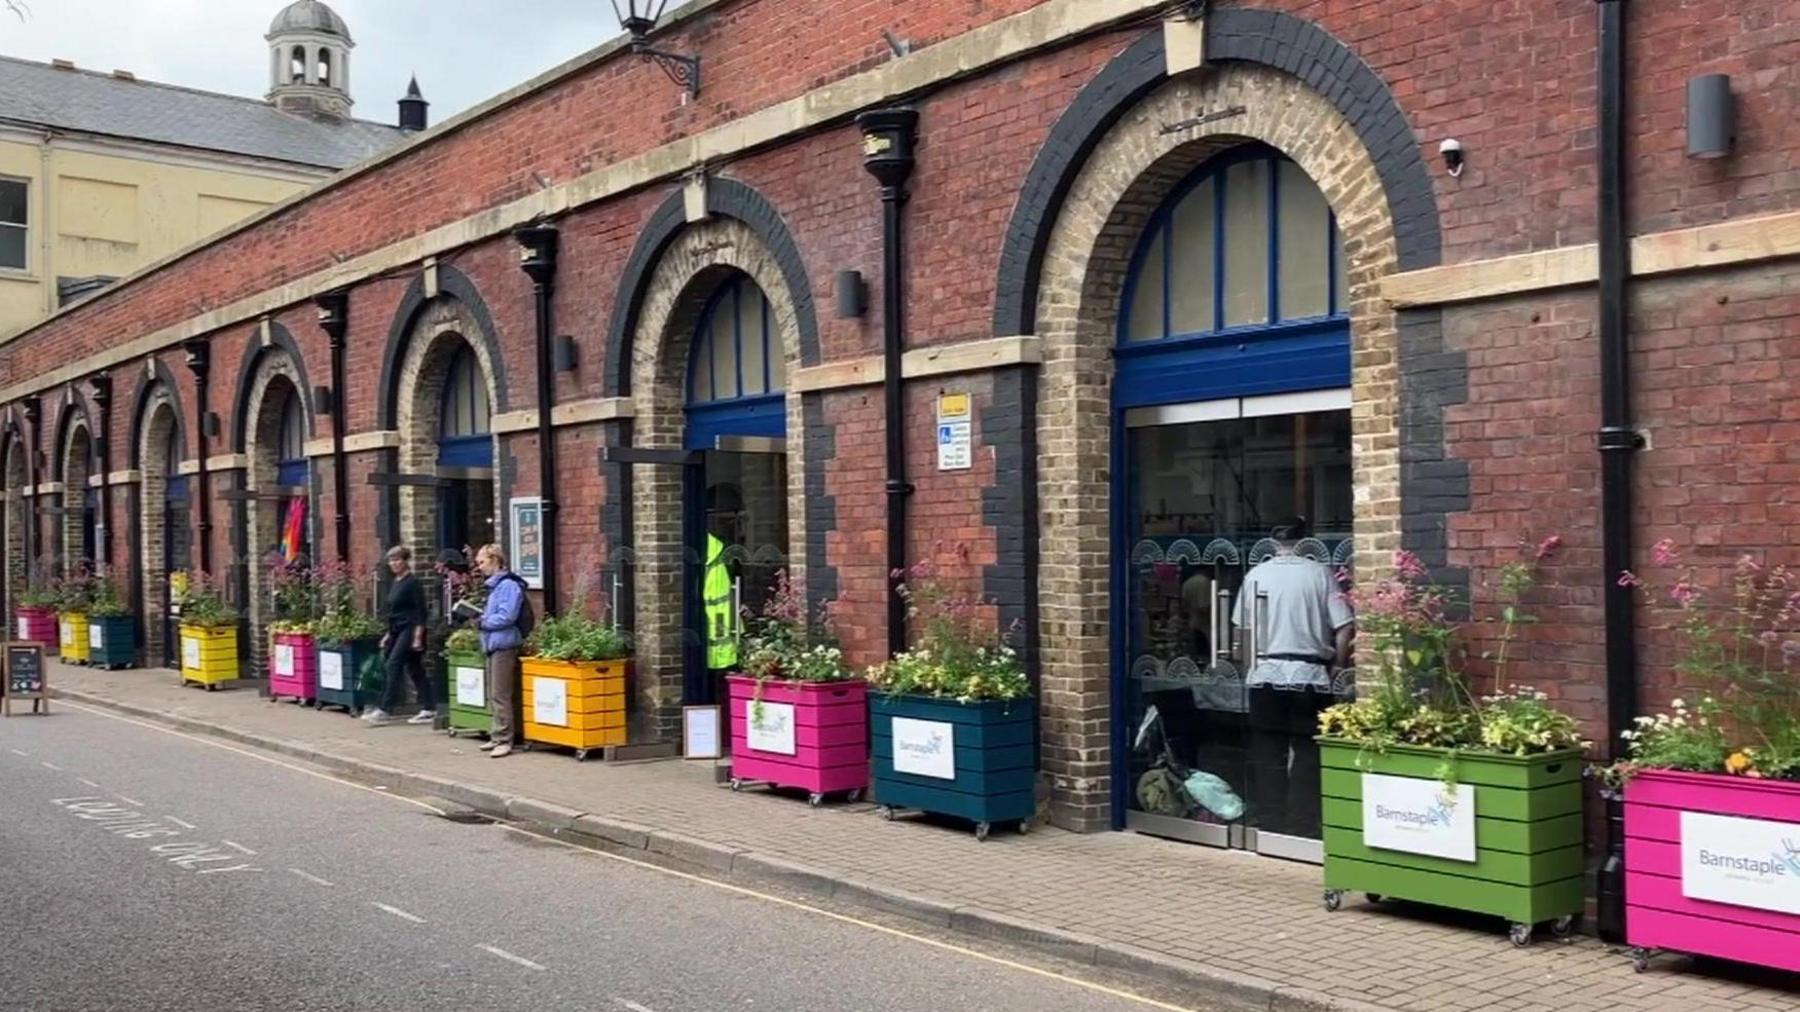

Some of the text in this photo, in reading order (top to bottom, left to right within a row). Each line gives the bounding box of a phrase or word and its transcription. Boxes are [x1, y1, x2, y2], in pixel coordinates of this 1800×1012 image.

[1376, 804, 1438, 827] Barnstaple
[51, 796, 263, 873] LOADING ONLY
[1699, 849, 1786, 876] Barnstaple
